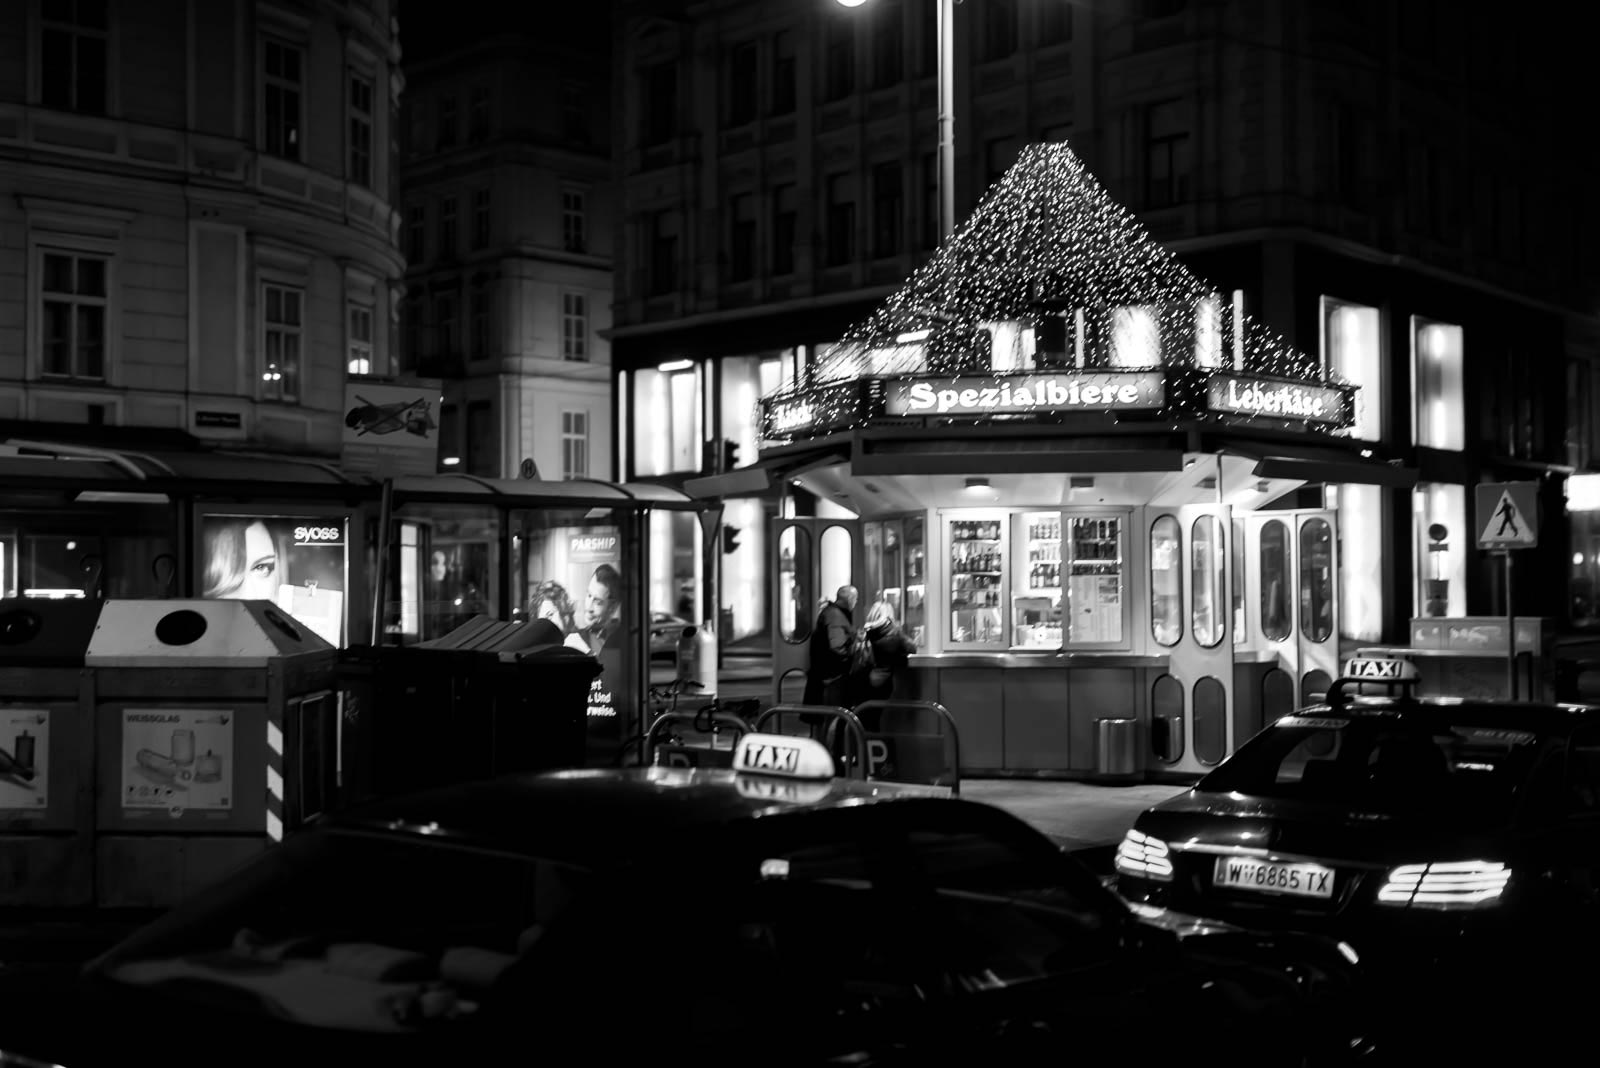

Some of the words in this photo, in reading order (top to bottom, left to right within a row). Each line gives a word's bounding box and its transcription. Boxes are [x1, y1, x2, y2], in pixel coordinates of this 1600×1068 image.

[910, 380, 1139, 412] Spezialbiere
[1228, 379, 1323, 416] Leberkäse
[294, 526, 339, 543] syoss
[571, 537, 616, 551] PARSHIP
[1353, 660, 1401, 676] TAXI
[127, 714, 180, 723] WEISSGLAS
[745, 743, 799, 772] TAXI
[866, 739, 889, 775] P
[1230, 863, 1242, 882] W
[1256, 865, 1301, 889] 6865
[1307, 871, 1329, 892] TX
